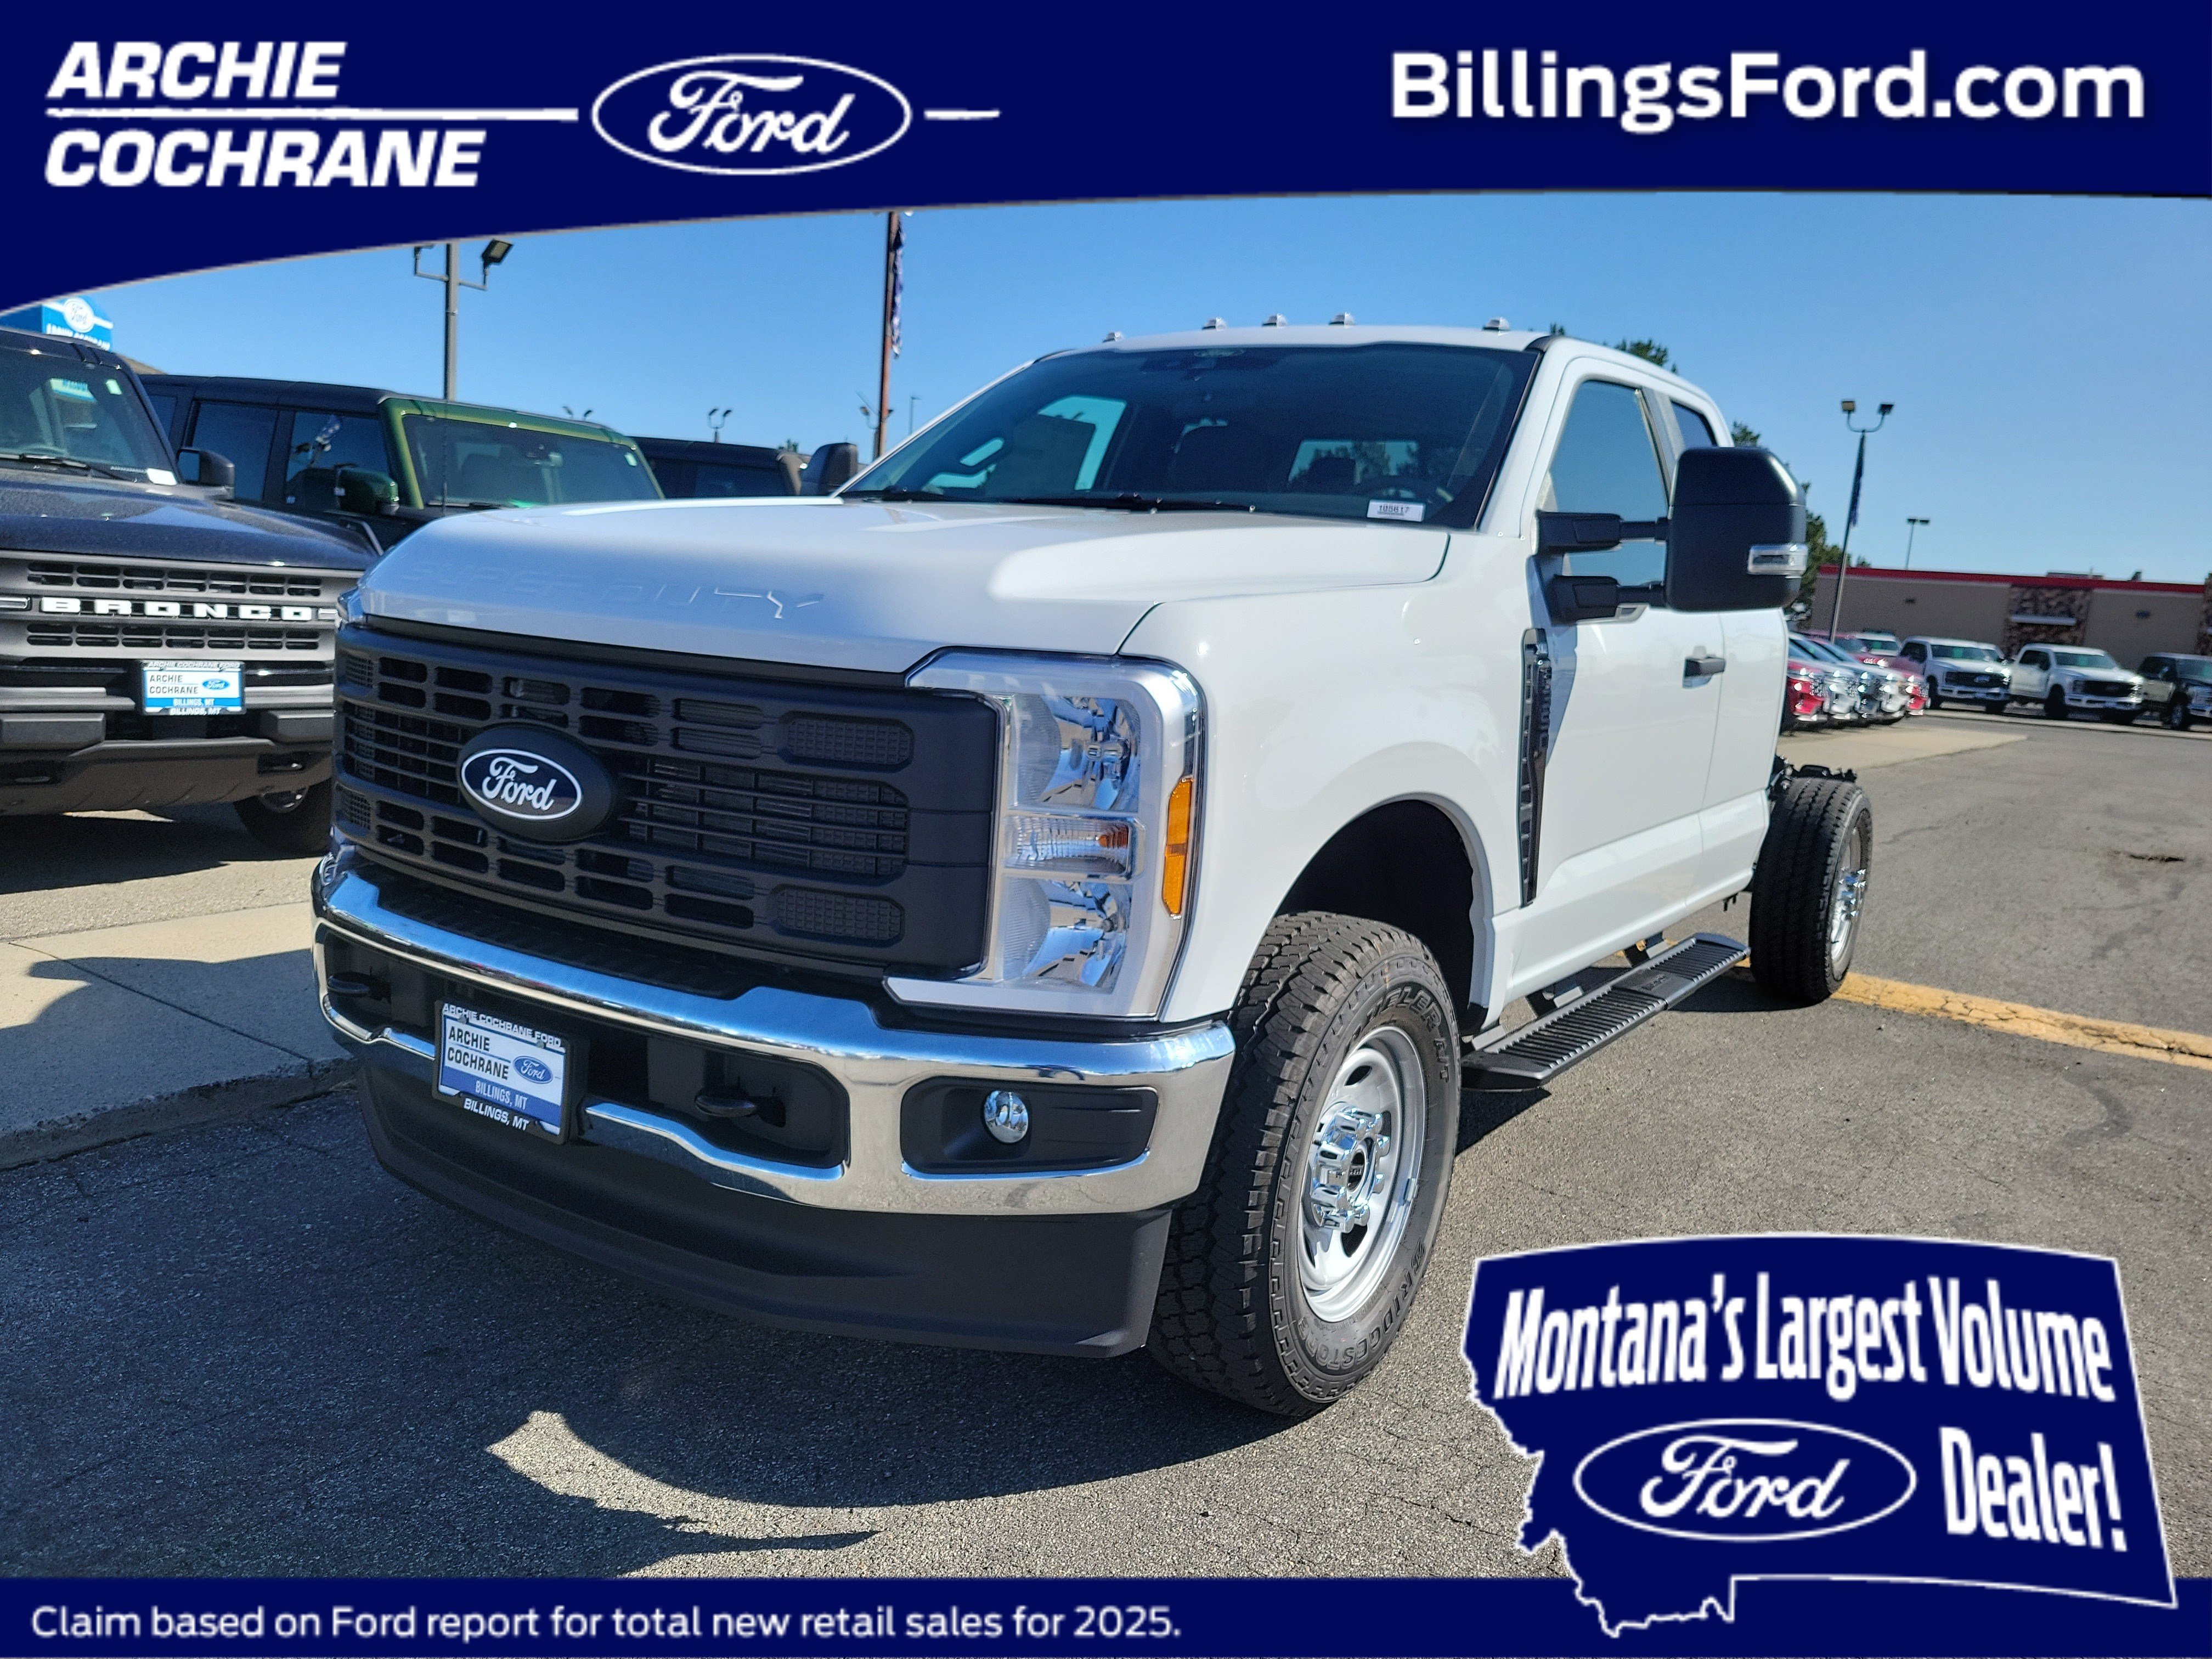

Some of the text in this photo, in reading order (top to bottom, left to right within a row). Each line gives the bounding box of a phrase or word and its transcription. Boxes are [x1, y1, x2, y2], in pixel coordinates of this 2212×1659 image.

[41, 596, 312, 621] BRONCO
[149, 686, 199, 694] COCHRANE
[150, 674, 183, 682] ARCHIE
[482, 757, 557, 811] Ford
[442, 1003, 562, 1047] ARCHIE COCHRANE FORD
[448, 1025, 490, 1052] ARCHIE
[447, 1046, 510, 1080] COCHRANE
[475, 1080, 529, 1110] BILLINGS, MT
[463, 1098, 530, 1131] BILLINGS, MT
